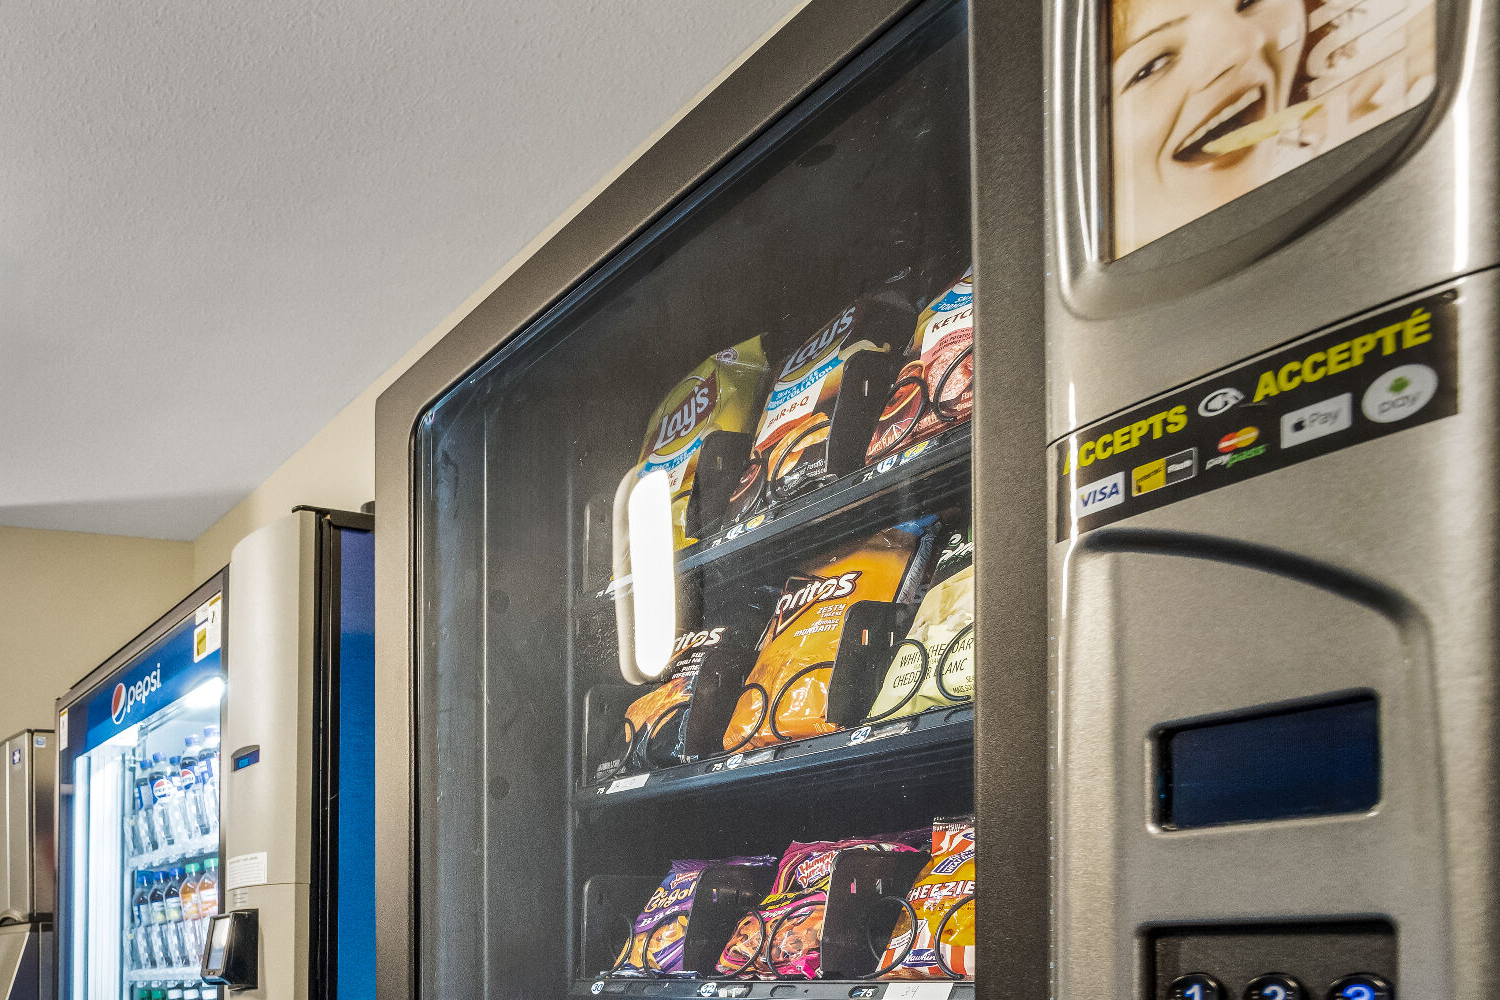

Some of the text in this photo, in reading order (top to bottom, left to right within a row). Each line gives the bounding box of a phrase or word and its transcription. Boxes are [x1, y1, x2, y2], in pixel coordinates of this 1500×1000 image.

[779, 306, 856, 379] Lay's
[1062, 307, 1433, 476] ACCEPTS ACCEPTÉ
[1377, 391, 1422, 415] pay
[653, 386, 709, 452] Lay's
[1306, 407, 1342, 428] Pay
[879, 457, 894, 470] 14
[1079, 481, 1121, 508] VISA
[775, 573, 858, 615] oritos
[816, 603, 847, 615] ZESTY
[674, 627, 726, 652] ritos
[899, 651, 925, 669] WHIT
[934, 658, 969, 679] LANC
[127, 663, 161, 713] pepsi
[853, 728, 870, 741] 24
[711, 762, 724, 772] 75
[860, 988, 875, 998] 75
